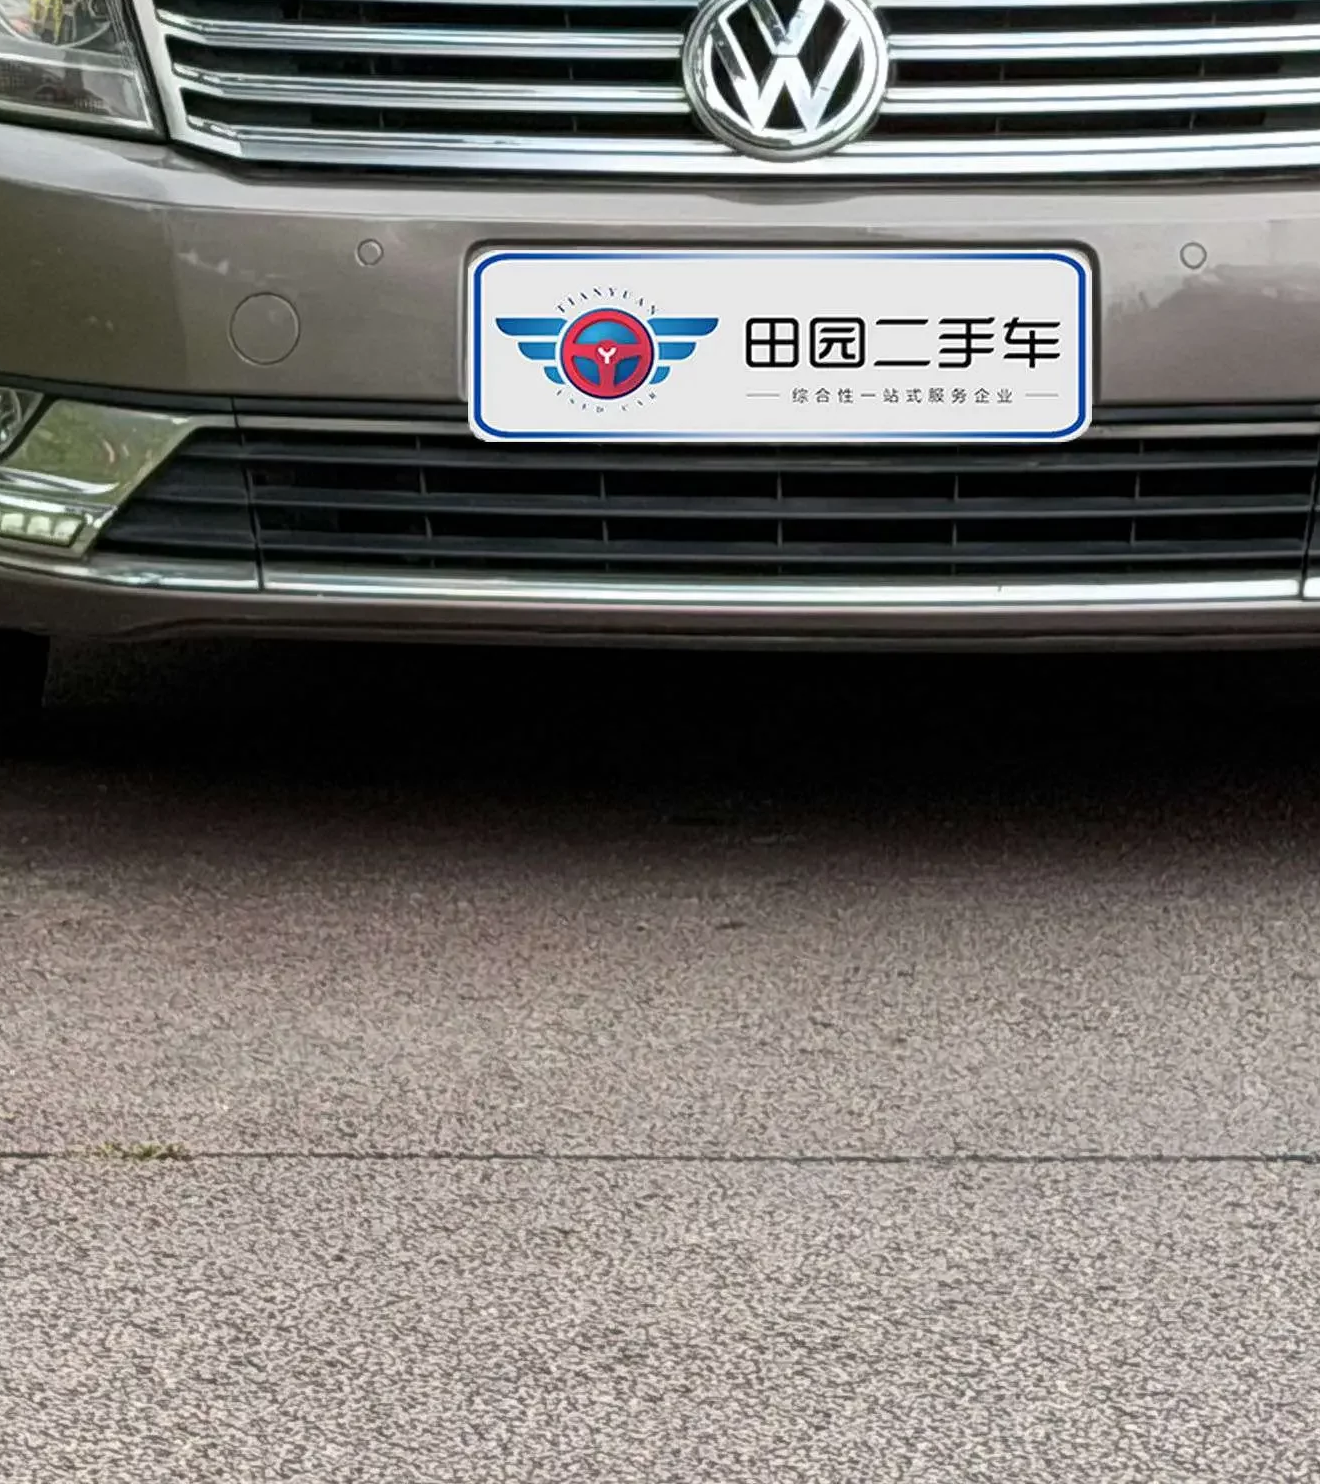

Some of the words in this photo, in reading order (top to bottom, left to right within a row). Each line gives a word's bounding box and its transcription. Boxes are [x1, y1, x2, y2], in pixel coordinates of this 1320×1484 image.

[745, 316, 1062, 369] 田园二手车
[791, 386, 1015, 405] 综合性一站式服务企业
